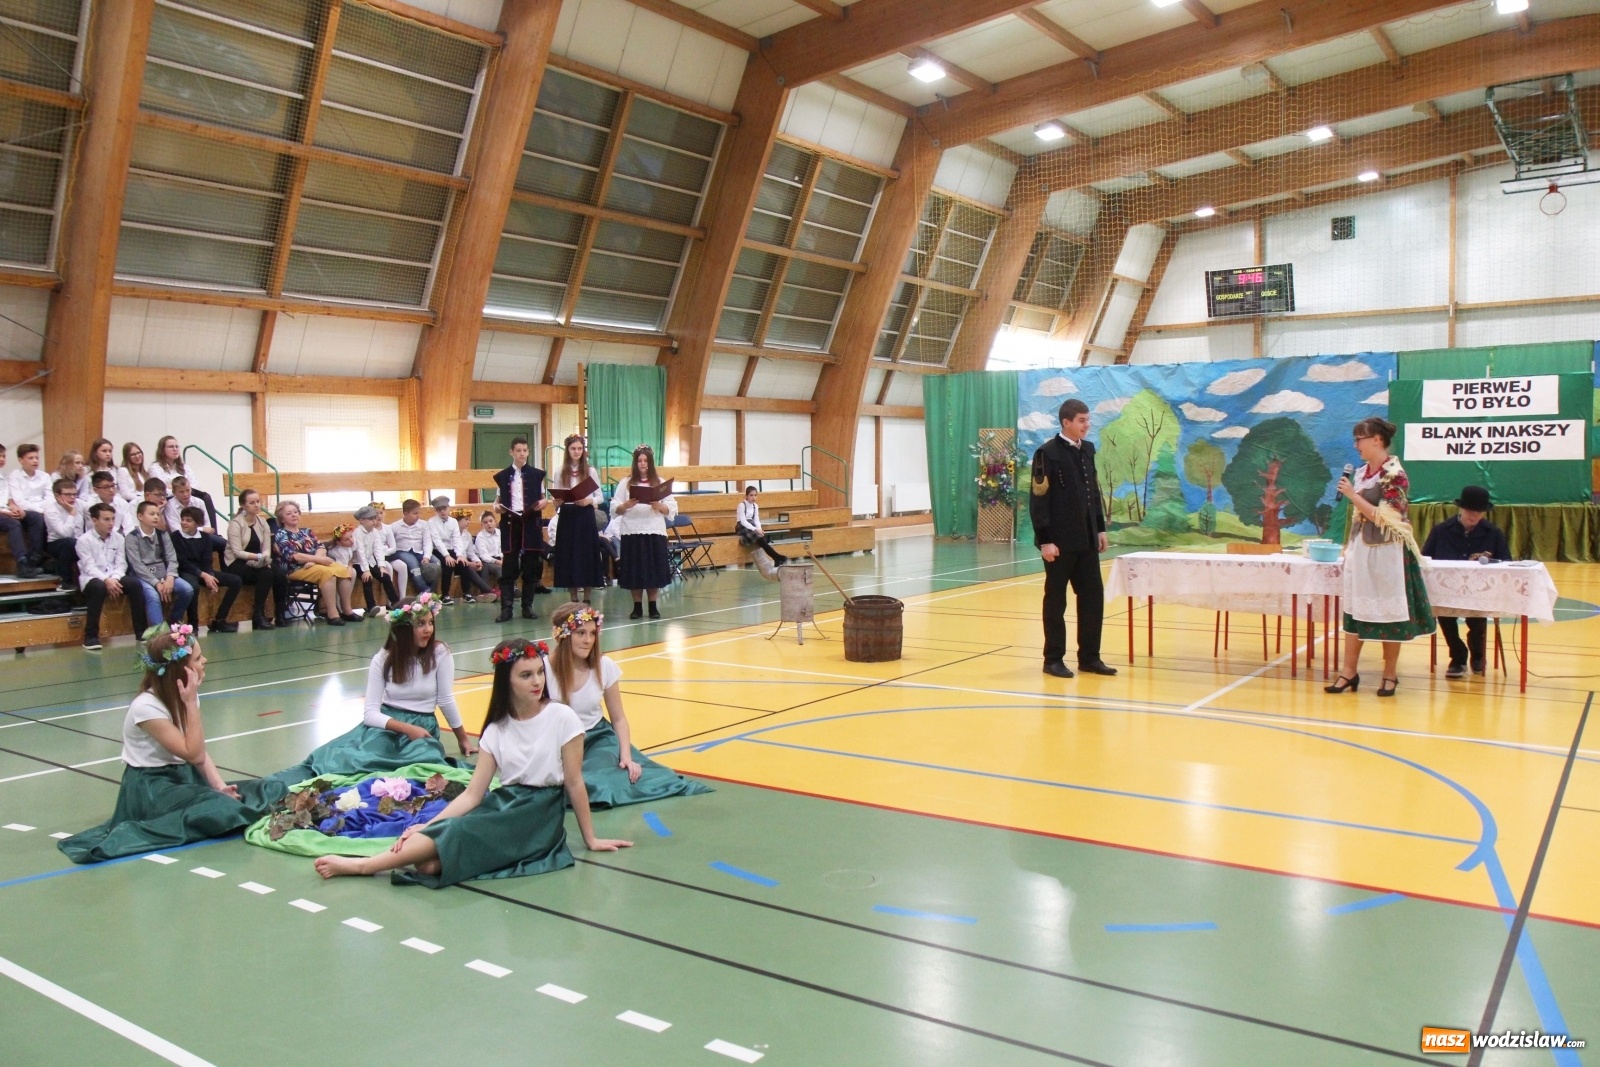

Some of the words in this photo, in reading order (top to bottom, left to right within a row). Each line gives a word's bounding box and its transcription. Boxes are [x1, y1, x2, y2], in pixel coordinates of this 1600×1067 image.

[1238, 273, 1263, 285] 9:46
[1452, 380, 1532, 395] PIERWEJ
[1452, 397, 1477, 410] TO
[1482, 395, 1531, 409] BYŁO
[1421, 426, 1483, 439] BLANK
[1487, 423, 1571, 438] INAKSZY
[1446, 439, 1477, 455] NIŻ
[1480, 440, 1541, 455] DZISIO
